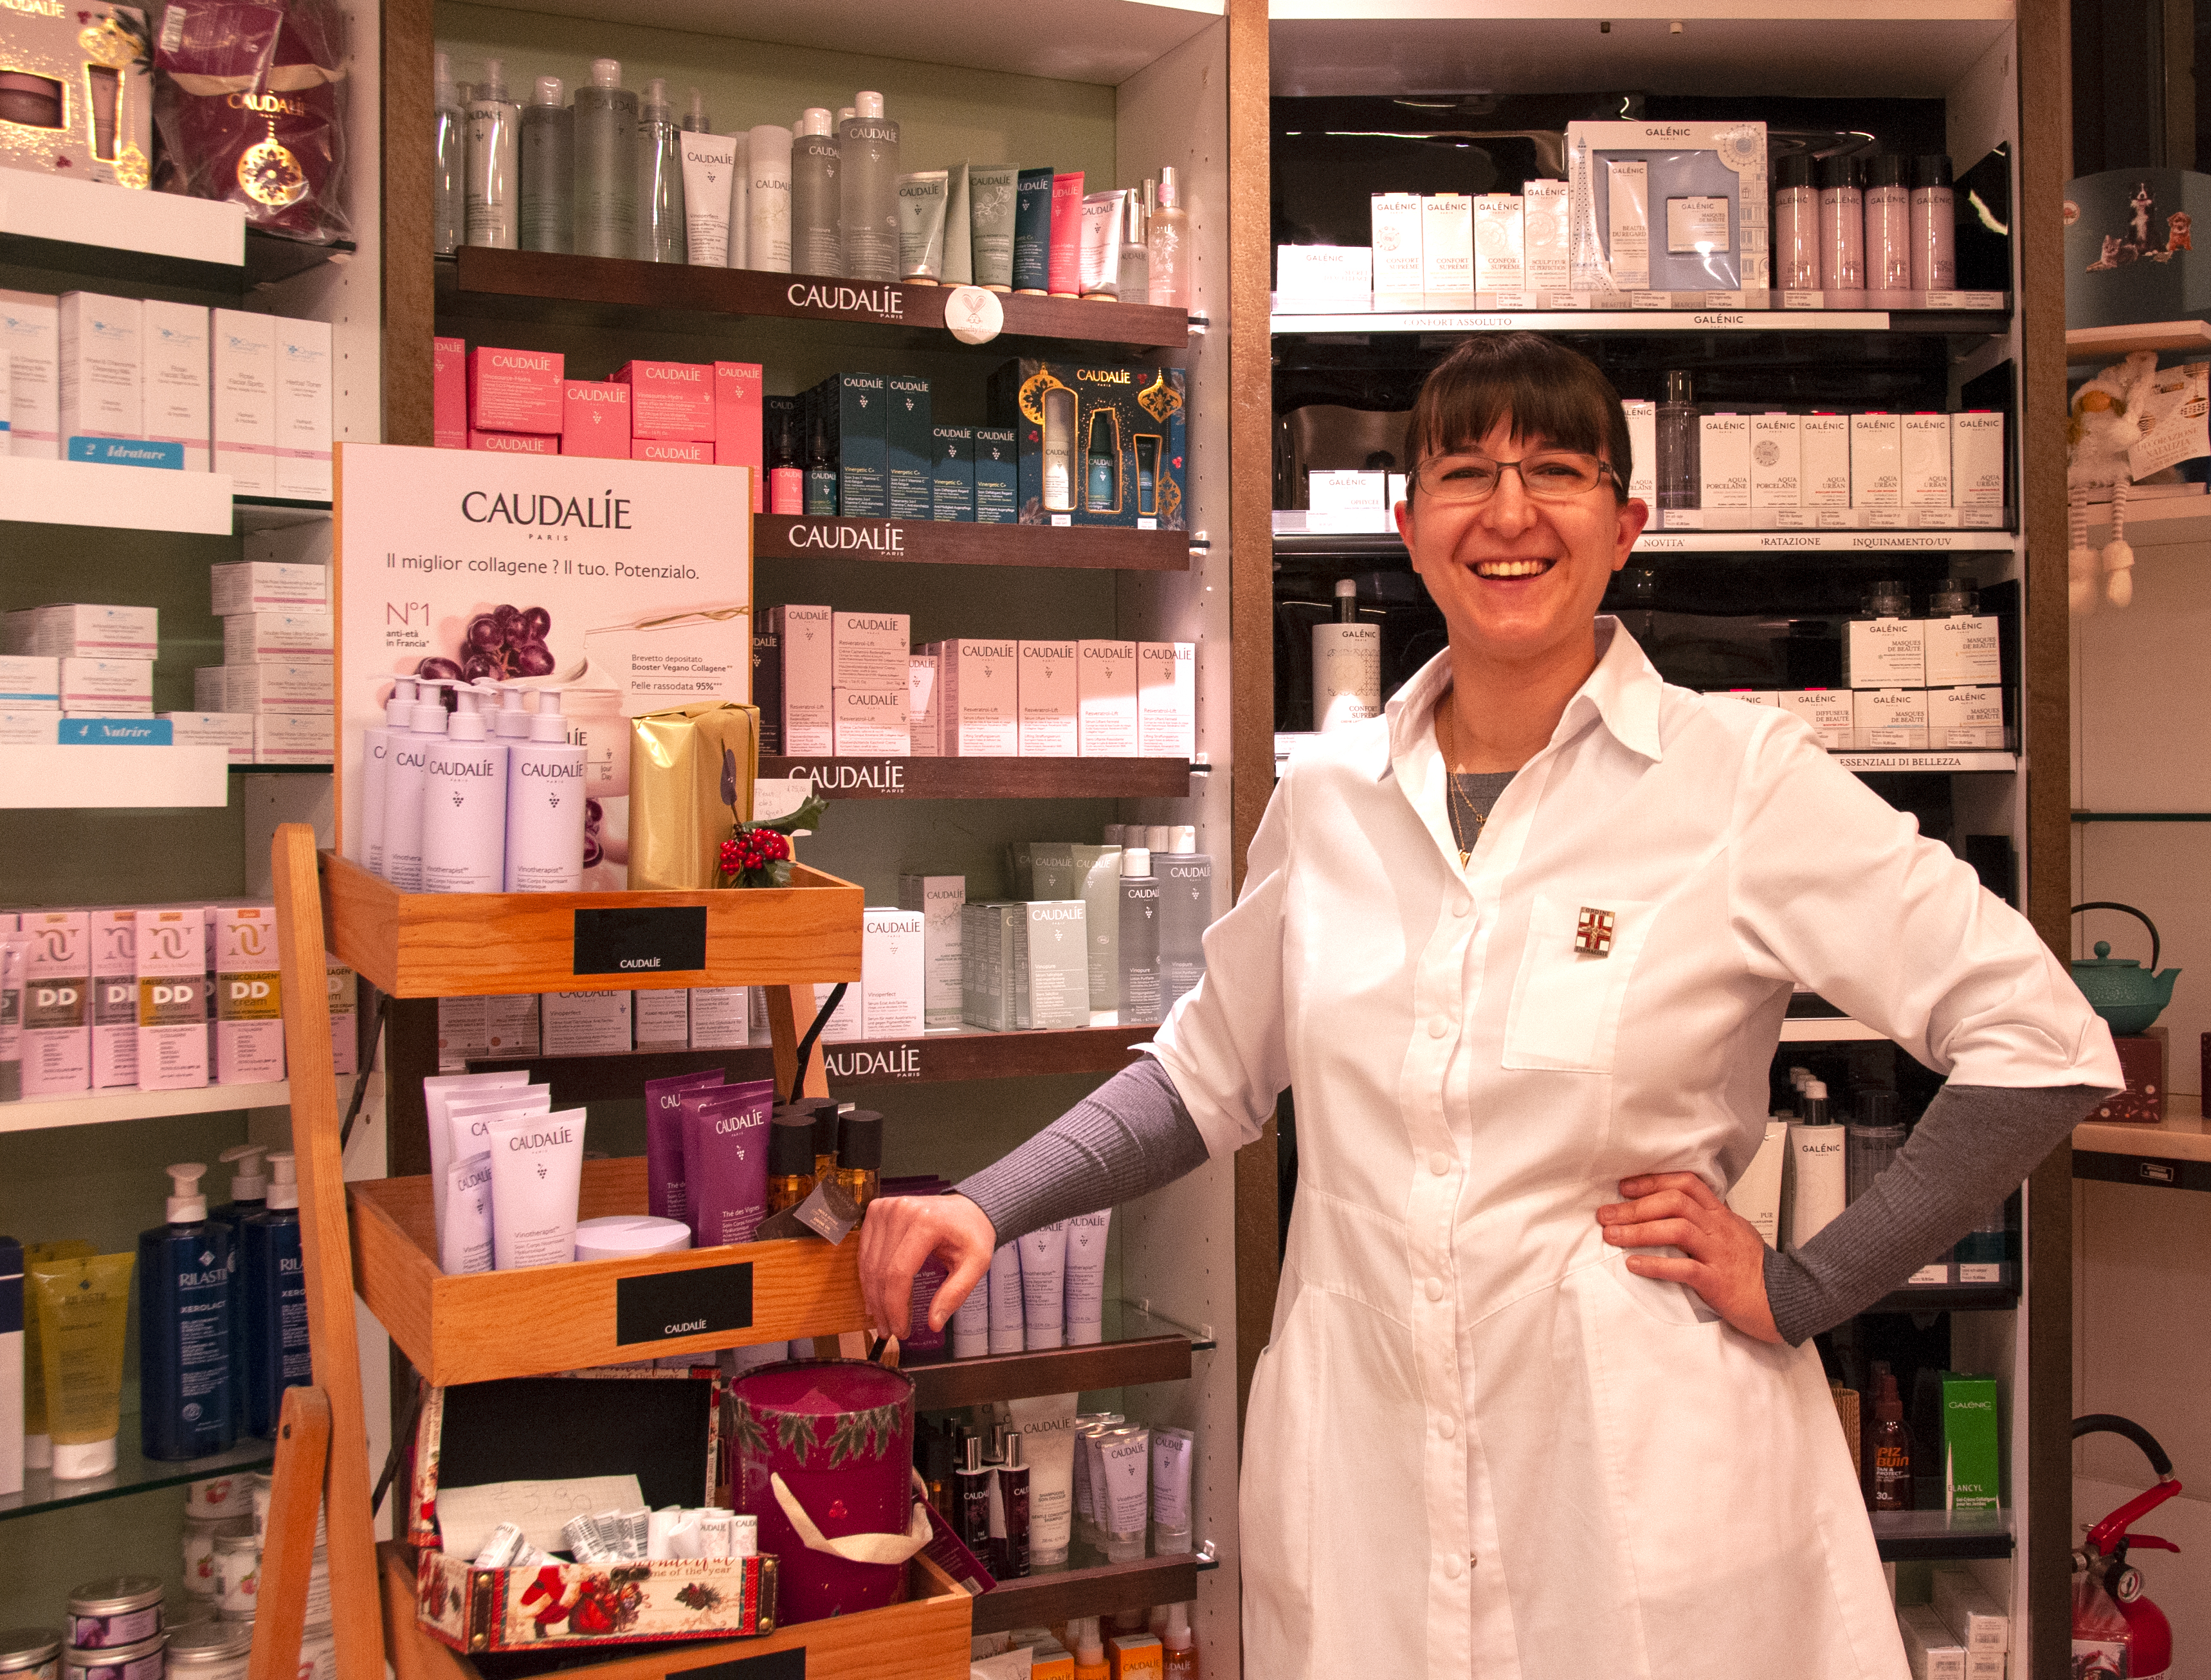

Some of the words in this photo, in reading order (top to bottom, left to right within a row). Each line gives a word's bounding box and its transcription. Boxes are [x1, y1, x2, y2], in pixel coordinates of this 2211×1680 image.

[850, 128, 896, 143] CAUDALÍE
[1646, 127, 1691, 136] GALÉNIC
[687, 152, 734, 165] CAUDALÍE
[971, 176, 1011, 187] CAUDALÍE
[900, 184, 938, 197] CAUDALÍE
[1528, 187, 1565, 196] GALÉNIC
[1377, 202, 1416, 210] GALÉNIC
[1428, 202, 1466, 210] GALÉNIC
[1479, 202, 1518, 210] GALÉNIC
[788, 284, 903, 314] CAUDALÍE
[1694, 314, 1743, 324] GALÉNIC
[493, 356, 551, 371] CAUDALÍE
[646, 368, 700, 381] CAUDALÍE
[719, 368, 760, 379] CAUDALÍE
[1077, 369, 1131, 384] CAUDALÍE
[844, 378, 884, 389] CAUDALÍE
[891, 381, 929, 392] CAUDALÍE
[568, 387, 626, 404] CAUDALÍE
[1706, 421, 1745, 430] GALÉNIC
[1756, 421, 1795, 430] GALÉNIC
[1805, 421, 1844, 430] GALÉNIC
[1857, 420, 1895, 429] GALÉNIC
[1906, 420, 1945, 429] GALÉNIC
[1960, 419, 1999, 428] GALÉNIC
[934, 428, 971, 439] CAUDALÍE
[978, 431, 1014, 441] CAUDALÍE
[86, 444, 95, 455] 2
[486, 438, 545, 452] CAUDALÍE
[646, 447, 700, 461] CAUDALÍE
[1329, 477, 1367, 486] GALÉNIC
[462, 489, 632, 529] CAUDALÍE
[789, 522, 904, 551] CAUDALÍE
[1644, 539, 1685, 547] NOVITA'
[1761, 537, 1821, 547] RATAZIONE
[1853, 538, 1952, 548] INQUINAMENTO/UV
[387, 553, 395, 568] Il
[403, 554, 462, 572] miglior
[468, 557, 547, 576] collagene
[552, 560, 559, 574] ?
[565, 560, 572, 574] Il
[578, 562, 609, 576] tuo.
[615, 562, 700, 580] Potenzialo.
[790, 610, 828, 620] CAUDALÍE
[848, 618, 898, 631] CAUDALÍE
[1870, 625, 1908, 633] GALÉNIC
[1945, 623, 1982, 631] GALÉNIC
[386, 629, 419, 637] anti-età
[1342, 630, 1376, 638] GALÉNIC
[387, 639, 394, 647] in
[963, 644, 1014, 657] CAUDALÍE
[1024, 645, 1073, 658] CAUDALÍE
[1084, 645, 1133, 659] CAUDALÍE
[1143, 648, 1192, 660] CAUDALÍE
[848, 693, 898, 706] CAUDALÍE
[1873, 695, 1911, 704] GALÉNIC
[1948, 693, 1986, 702] GALÉNIC
[80, 726, 88, 736] 4
[103, 725, 151, 738] Nutrire
[1840, 758, 1895, 766] ESSENZIALI
[1913, 758, 1961, 766] BELLEZZA
[430, 760, 494, 777] CAUDALÍE
[522, 761, 583, 778] CAUDALÍE
[789, 760, 904, 789] CAUDALÍE
[927, 889, 964, 900] CAUDALÍE
[1032, 906, 1084, 920] CAUDALÍE
[867, 919, 920, 933] CAUDALÍE
[621, 957, 661, 968] CAUDALÍE
[152, 986, 193, 1004] DD
[232, 982, 270, 999] DD
[37, 988, 78, 1007] DD
[825, 1044, 921, 1076] AUDALÍE
[716, 1109, 764, 1135] CAUDALÍE
[510, 1126, 573, 1151] CAUDALÍE
[1803, 1143, 1840, 1153] GALÉNIC
[745, 1205, 760, 1214] Vignes
[179, 1269, 227, 1286] RILASTI
[665, 1319, 707, 1334] CAUDALÍE
[1024, 1418, 1071, 1434] CAUDALÍE
[1877, 1447, 1902, 1457] PIZ
[1877, 1492, 1888, 1500] 30
[669, 1567, 681, 1576] of
[685, 1567, 701, 1575] the
[708, 1567, 732, 1577] year
